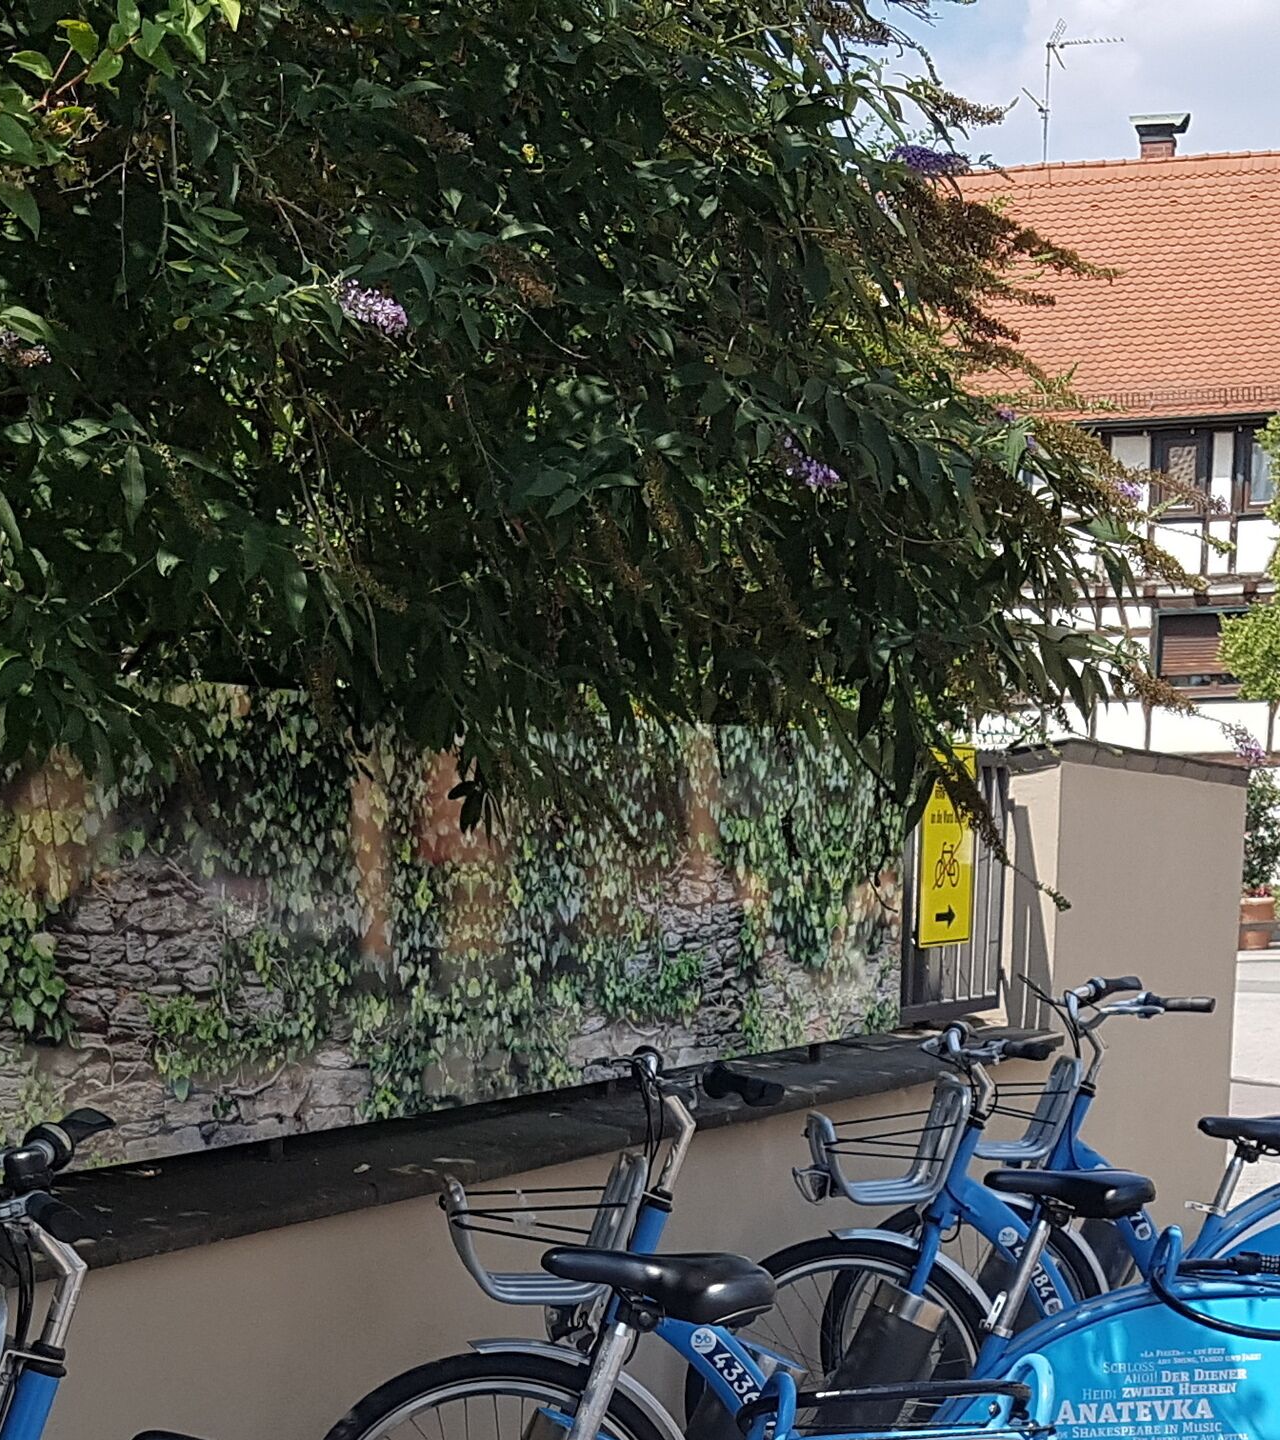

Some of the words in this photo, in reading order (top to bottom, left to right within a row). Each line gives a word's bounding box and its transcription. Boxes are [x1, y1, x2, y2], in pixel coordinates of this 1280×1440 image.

[1103, 1361, 1155, 1374] SCHLOSS
[1161, 1370, 1190, 1383] DER
[1194, 1368, 1248, 1382] DIENER
[1082, 1388, 1117, 1401] HEIDI
[1122, 1385, 1174, 1399] ZWEIER
[1178, 1382, 1238, 1396] HERREN
[1055, 1398, 1214, 1426] ANATEVKA
[1072, 1424, 1162, 1439] SHAKESPEARE
[1164, 1423, 1179, 1434] IN
[1182, 1421, 1223, 1434] MUSIC
